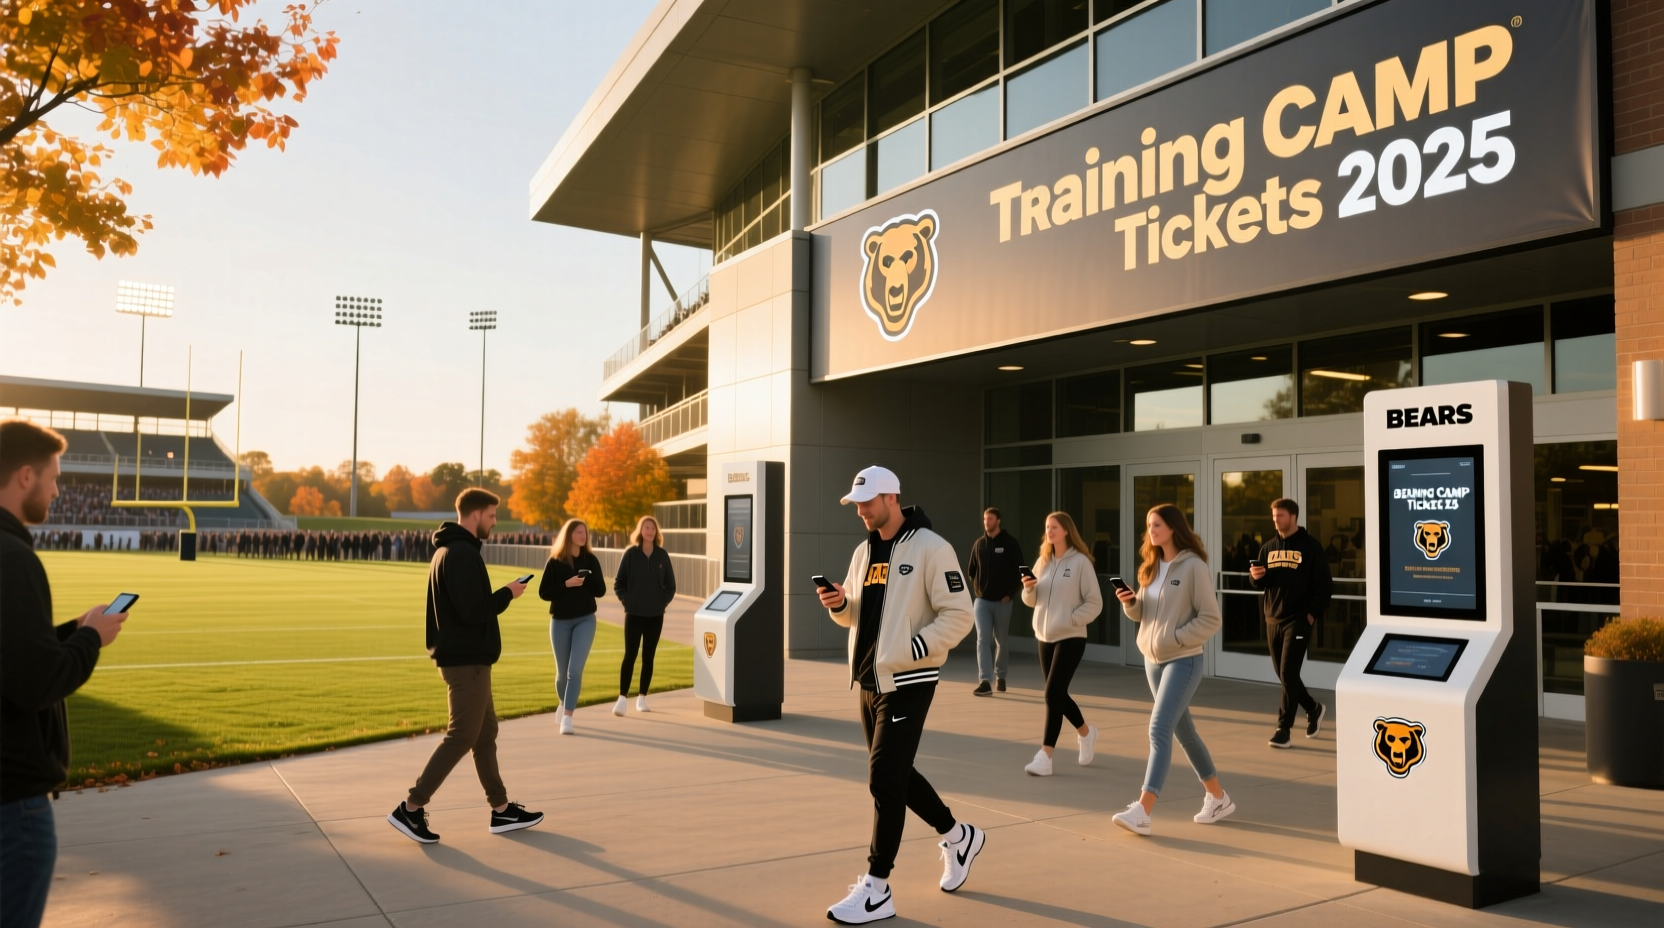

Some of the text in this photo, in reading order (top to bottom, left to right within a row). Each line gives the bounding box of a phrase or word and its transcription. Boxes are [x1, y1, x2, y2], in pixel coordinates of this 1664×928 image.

[1263, 25, 1513, 158] CAMP
[1115, 110, 1516, 271] Tickets 2025
[1386, 403, 1474, 429] BEARS
[1436, 486, 1470, 499] CAMP
